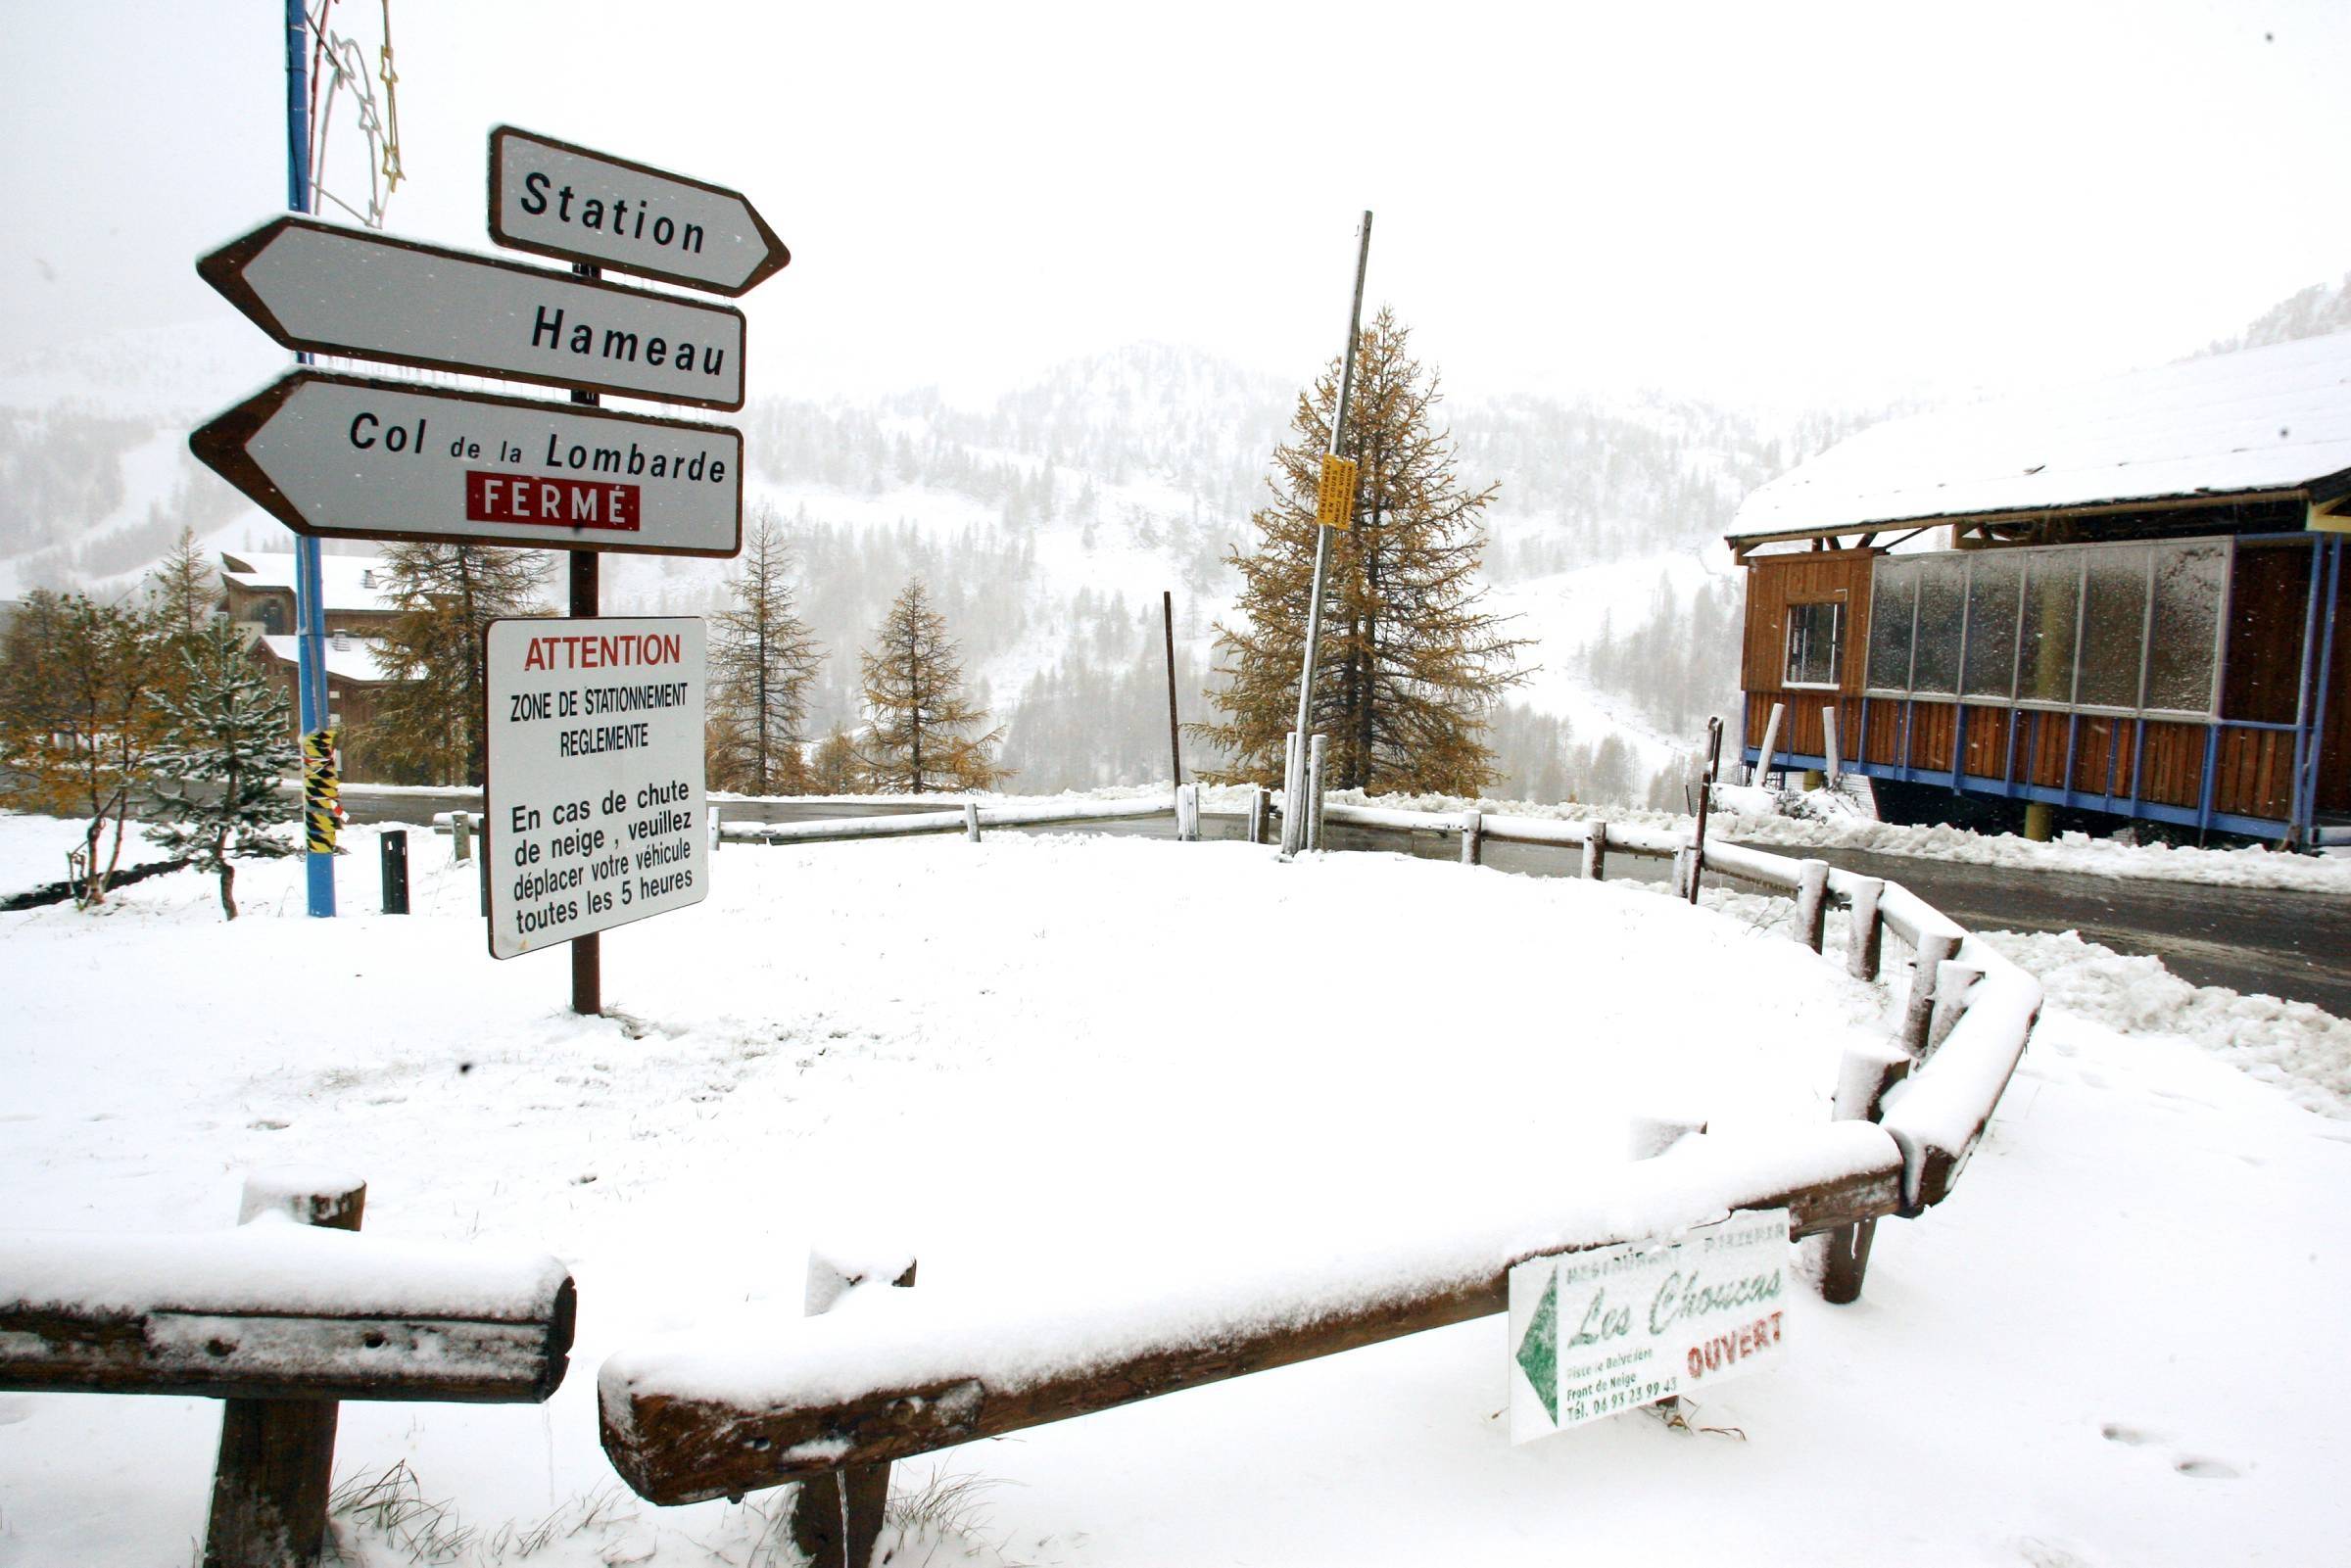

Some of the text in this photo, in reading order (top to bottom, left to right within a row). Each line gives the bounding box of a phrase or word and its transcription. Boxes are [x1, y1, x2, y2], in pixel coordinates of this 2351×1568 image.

[520, 171, 704, 254] Station
[531, 305, 725, 376] Hameau
[349, 411, 726, 484] Col de la Lombarde
[483, 479, 627, 524] FERMÉ
[524, 634, 681, 672] ATTENTION
[510, 682, 689, 723] ZONE DE STATIONNEMENT
[560, 723, 649, 758] REGLEMENTE
[511, 780, 690, 834] En cas de chute
[513, 836, 692, 902] déplacer votre véhicule
[514, 838, 541, 867] de
[552, 828, 605, 858] neige
[628, 810, 693, 841] veuillez
[516, 869, 693, 934] toutes les 5 heures
[1566, 1285, 1631, 1350] Les
[1686, 1310, 1784, 1380] OUVERT
[1567, 1372, 1637, 1402] Front de Neige
